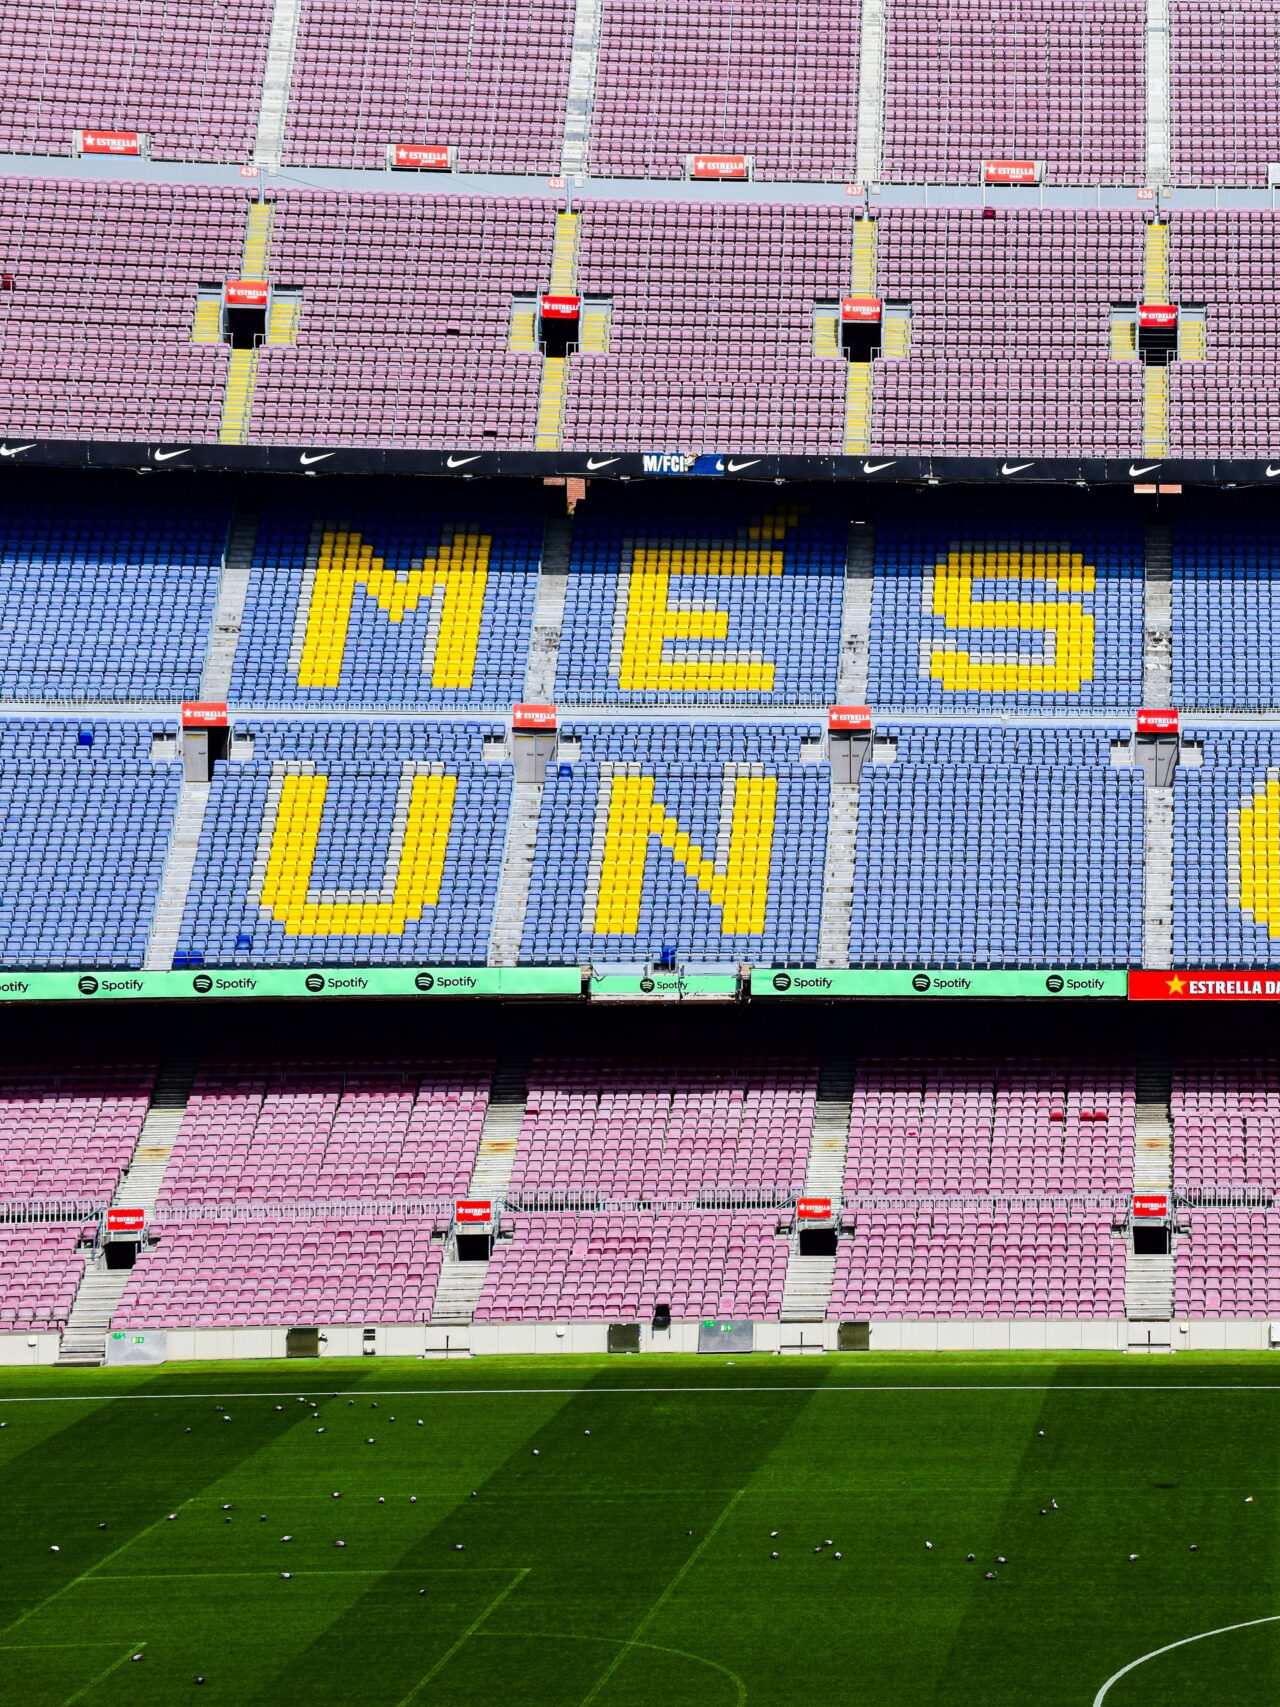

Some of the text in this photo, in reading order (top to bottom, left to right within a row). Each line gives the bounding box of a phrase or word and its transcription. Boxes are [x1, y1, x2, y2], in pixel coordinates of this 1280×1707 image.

[96, 138, 137, 147] ESTRELLA
[409, 151, 447, 160] ESTRELLA
[707, 162, 744, 170] ESTRELLA
[998, 167, 1033, 175] ESTRELLA
[241, 167, 258, 177] 439
[548, 179, 565, 188] 438
[846, 186, 863, 196] 437
[1137, 190, 1153, 199] 436
[237, 289, 268, 297] ESTRELLA
[260, 775, 778, 935] UN
[101, 980, 144, 992] Spotify
[215, 978, 257, 990] Spotify
[327, 977, 368, 989] Spotify
[437, 976, 477, 988] Spotify
[657, 981, 688, 990] Spotify
[794, 977, 832, 988] Spotify
[933, 978, 971, 989] Spotify
[1066, 978, 1105, 990] Spotify
[1189, 980, 1262, 994] ESTRELLA
[0, 982, 29, 993] otify
